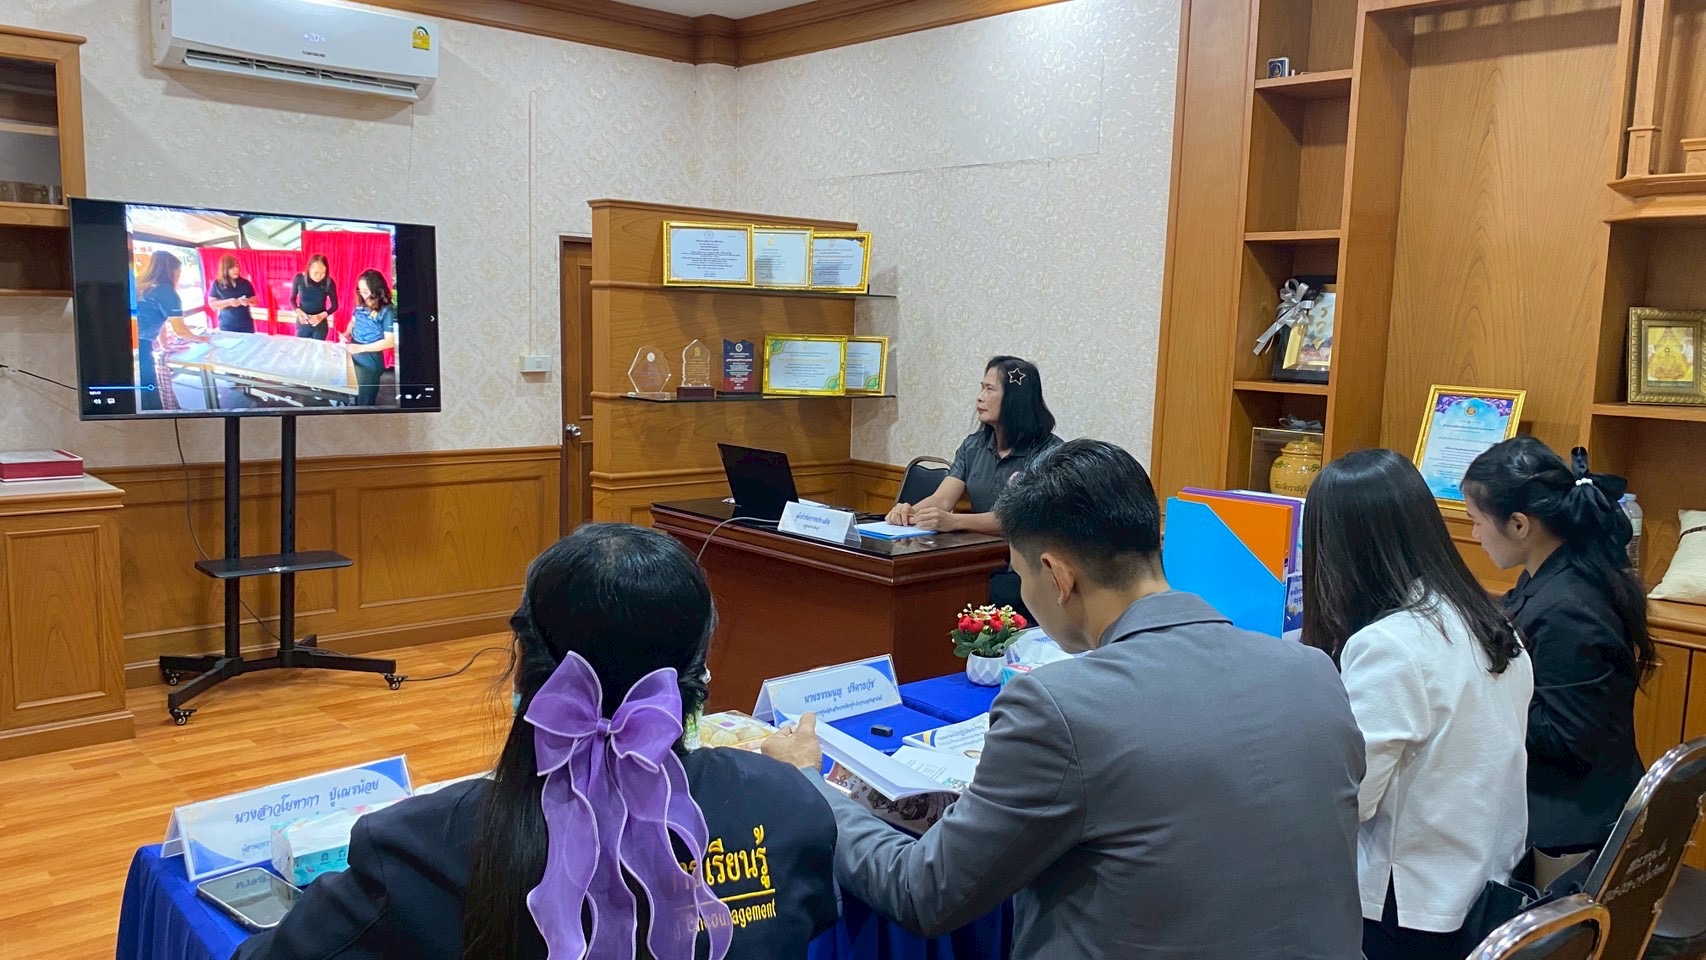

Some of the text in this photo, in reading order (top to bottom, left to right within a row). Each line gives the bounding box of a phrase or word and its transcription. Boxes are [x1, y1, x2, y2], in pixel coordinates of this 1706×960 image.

[234, 777, 380, 825] นางสาวโยทากา ปู่เณรน้อย
